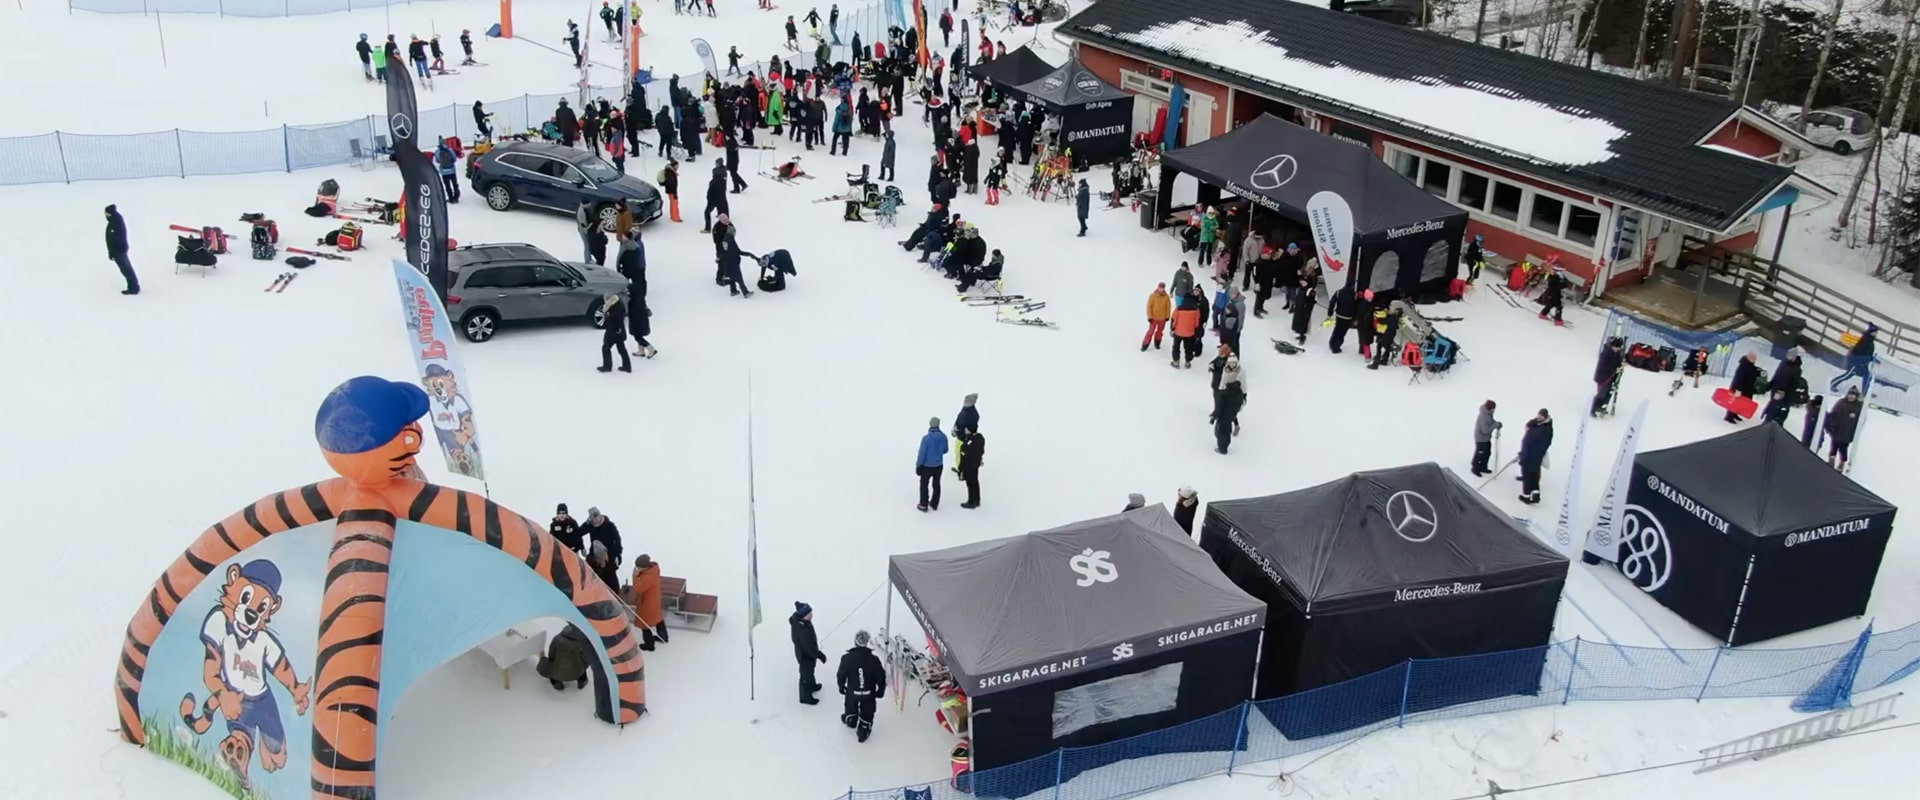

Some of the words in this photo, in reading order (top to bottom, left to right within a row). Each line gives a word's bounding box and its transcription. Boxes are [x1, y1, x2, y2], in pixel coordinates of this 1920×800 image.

[1076, 124, 1125, 139] MANDATUM
[1225, 180, 1280, 212] Mercedes-Benz
[1386, 219, 1445, 240] Mercedes-Benz
[1657, 481, 1730, 535] MANDATUM
[1796, 518, 1870, 544] MANDATUM
[1227, 527, 1282, 586] Mercedes-Benz
[1393, 581, 1482, 602] Mercedes-Benz
[979, 656, 1088, 689] SKIGARAGE.NET
[1157, 613, 1258, 647] SKIGARAGE.NET
